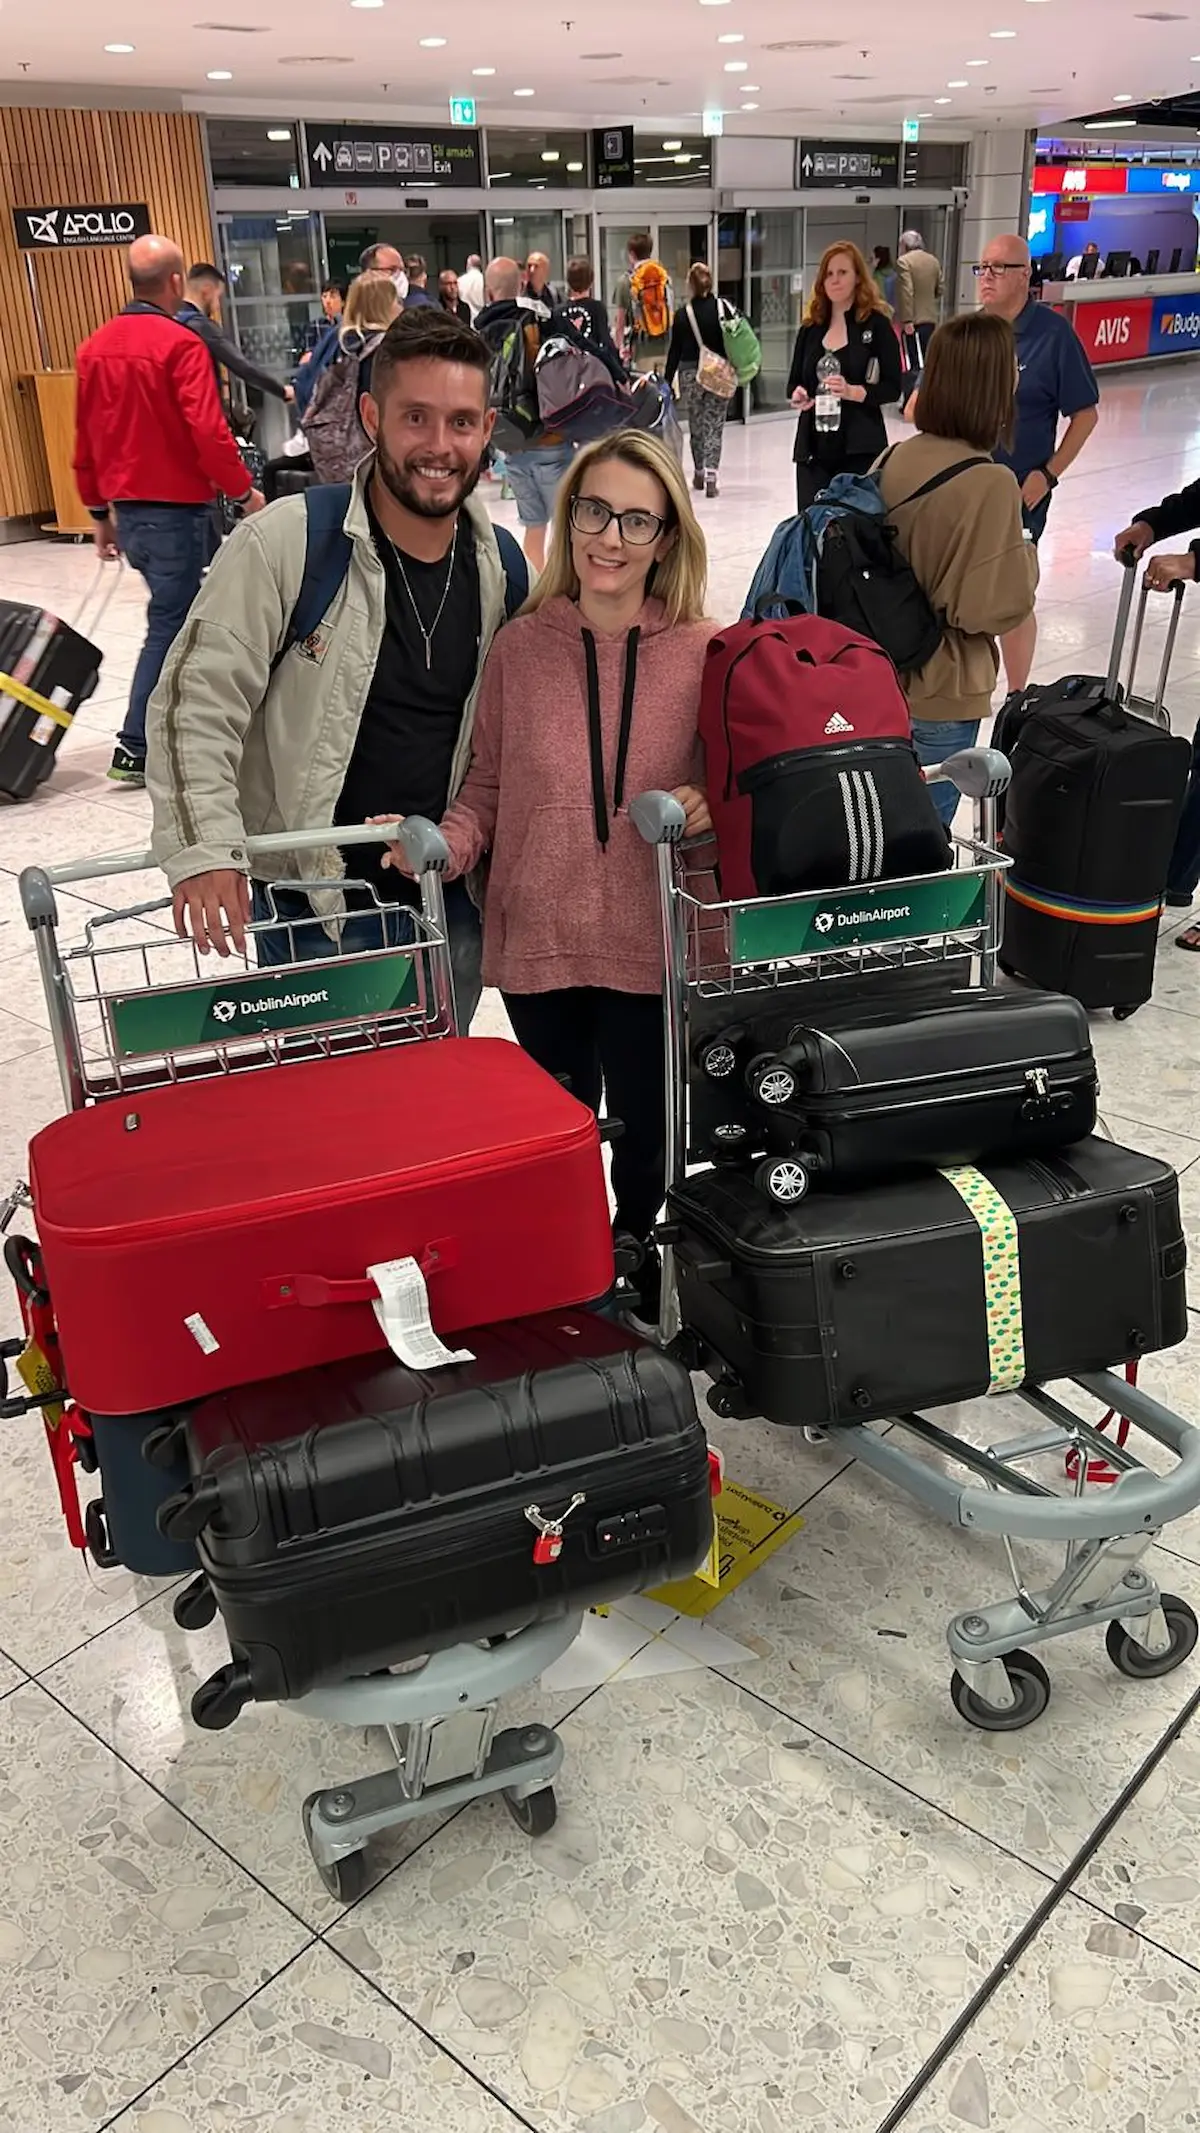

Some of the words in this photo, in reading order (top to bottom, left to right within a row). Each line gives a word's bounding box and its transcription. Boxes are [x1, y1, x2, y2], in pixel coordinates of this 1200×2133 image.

[446, 145, 474, 158] amach
[434, 161, 451, 173] Exit
[63, 212, 134, 235] APOLLO
[1094, 316, 1130, 346] AVIS
[824, 724, 854, 734] adidas
